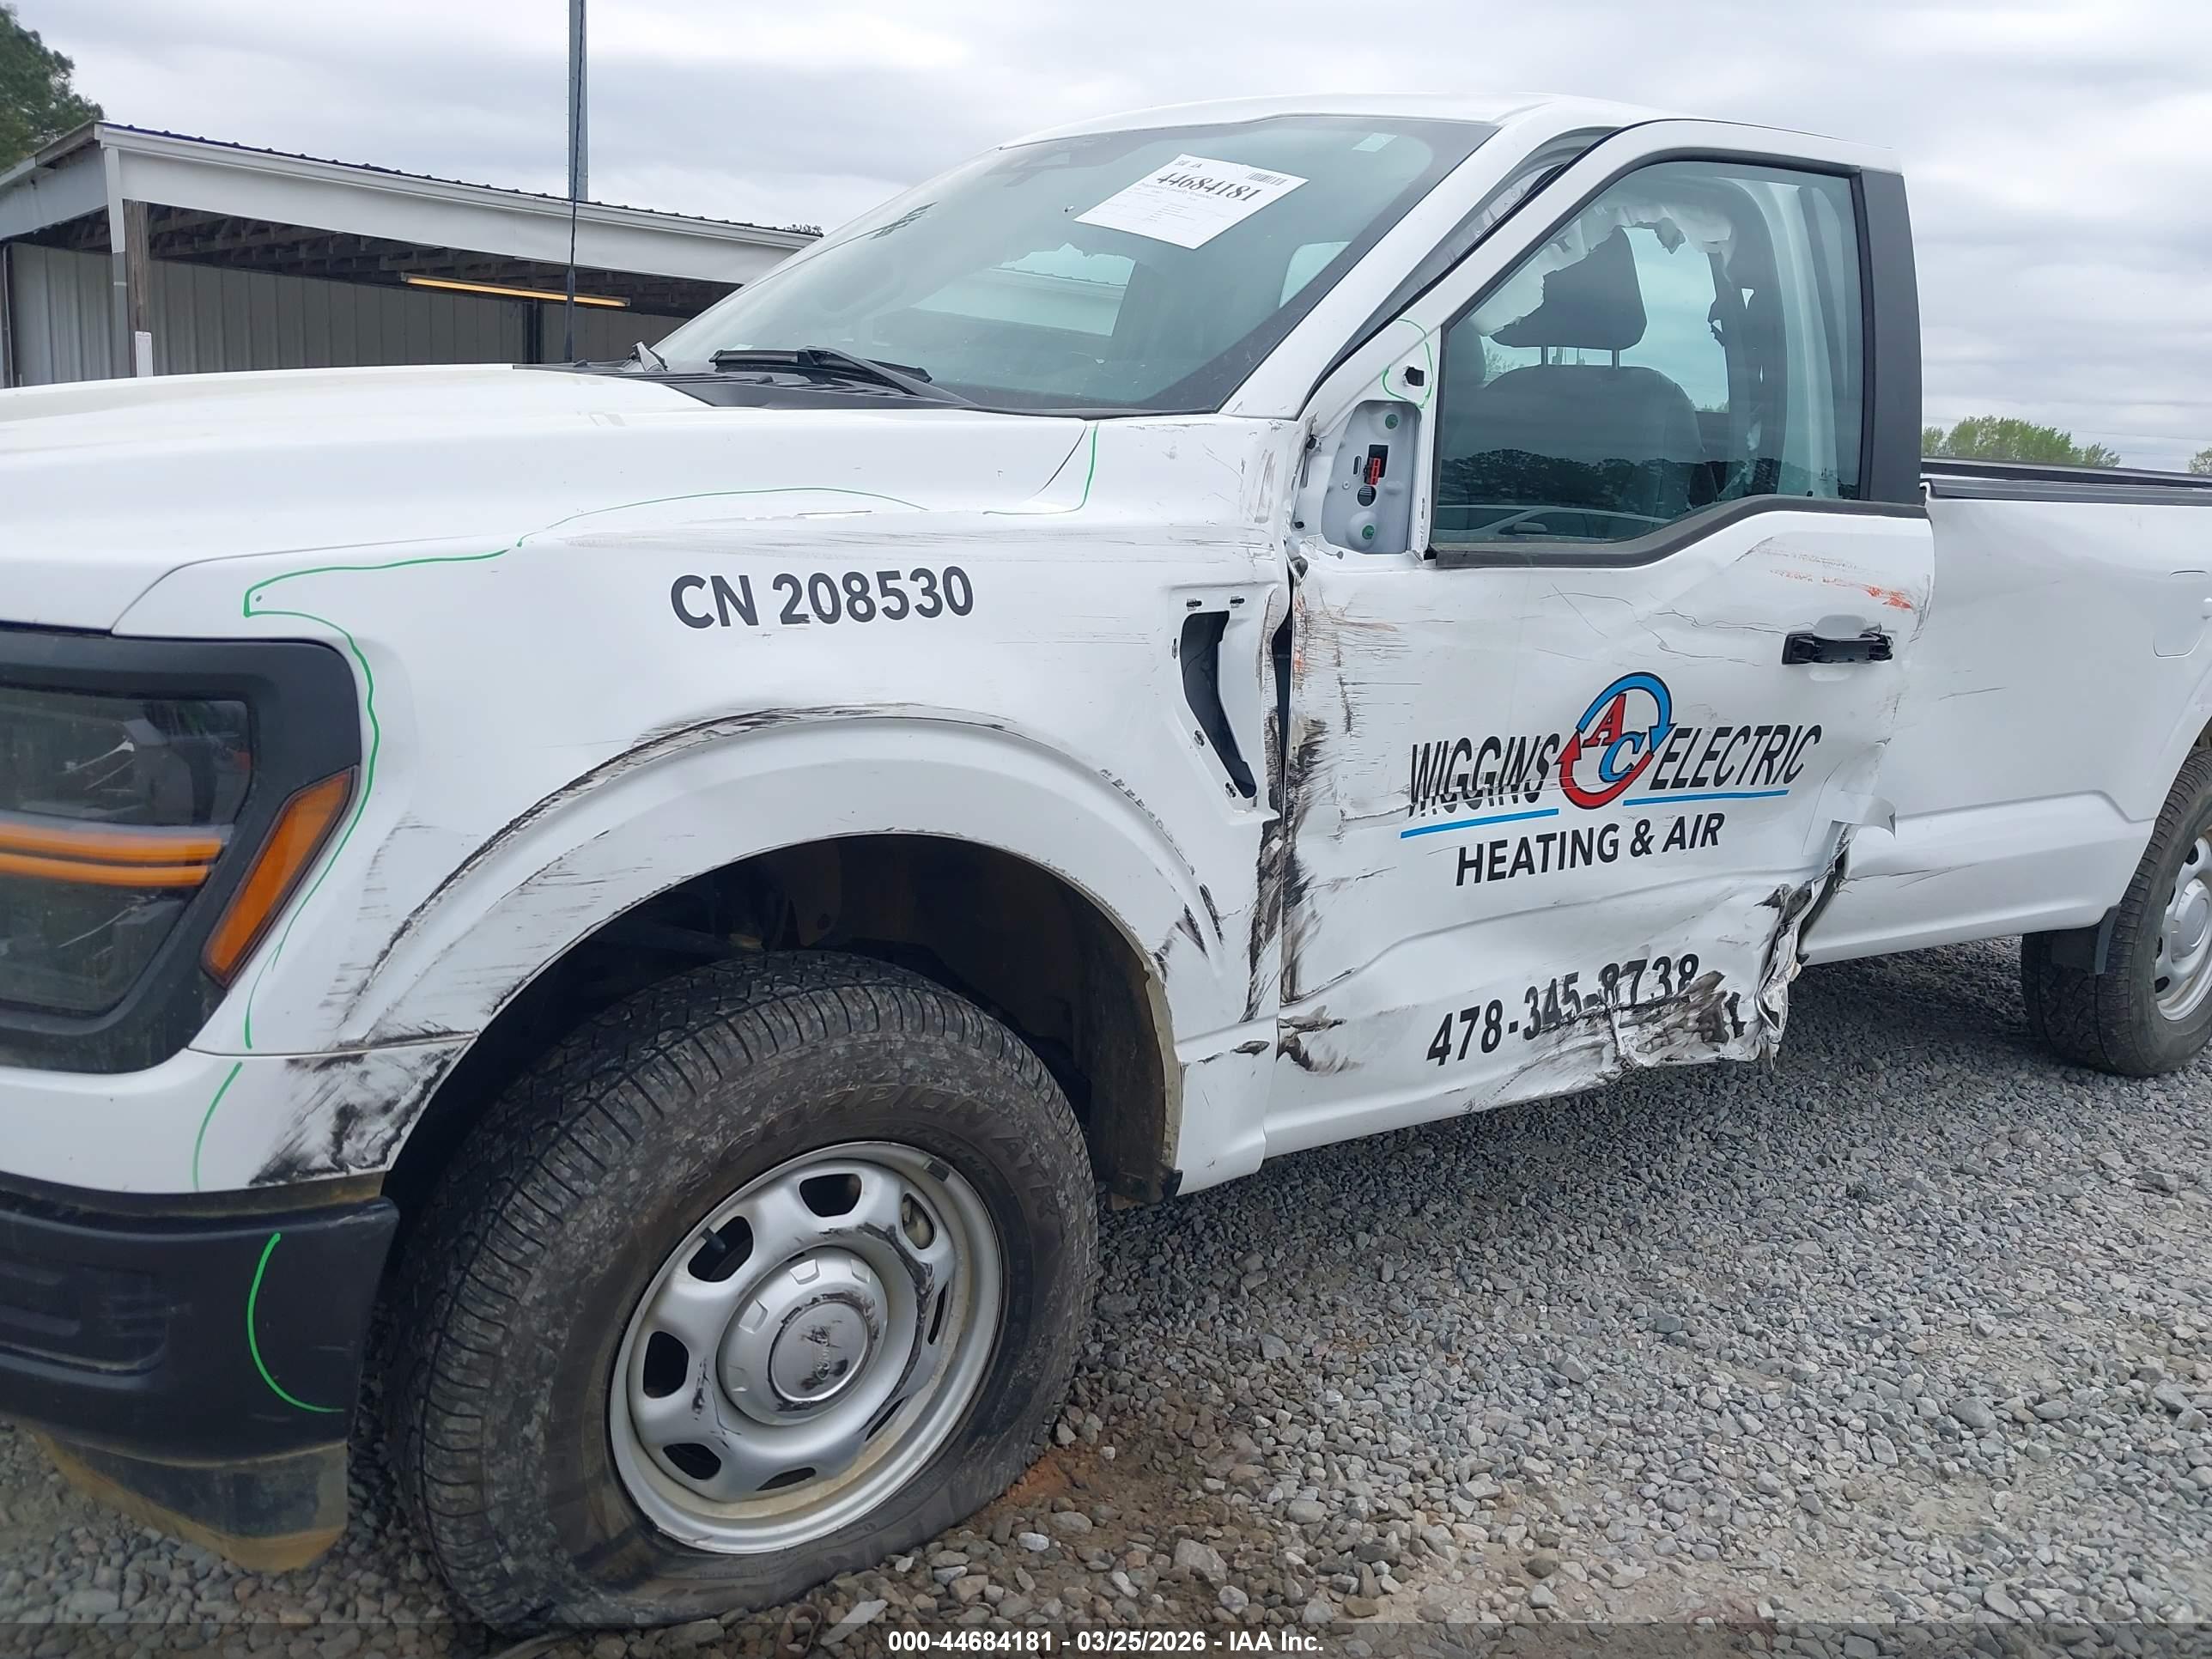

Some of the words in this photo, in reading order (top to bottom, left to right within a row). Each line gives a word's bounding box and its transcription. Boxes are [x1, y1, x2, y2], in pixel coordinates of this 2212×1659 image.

[1157, 172, 1263, 201] 44684181
[671, 574, 759, 629] CN
[772, 566, 974, 624] 208530
[1408, 732, 1561, 817] WIGGINS
[1649, 724, 1822, 791] ELECTRIC
[1455, 823, 1620, 887] HEATING
[1630, 818, 1654, 858] &
[1662, 813, 1726, 853] AIR
[1425, 953, 1699, 1066] 478-345-8738
